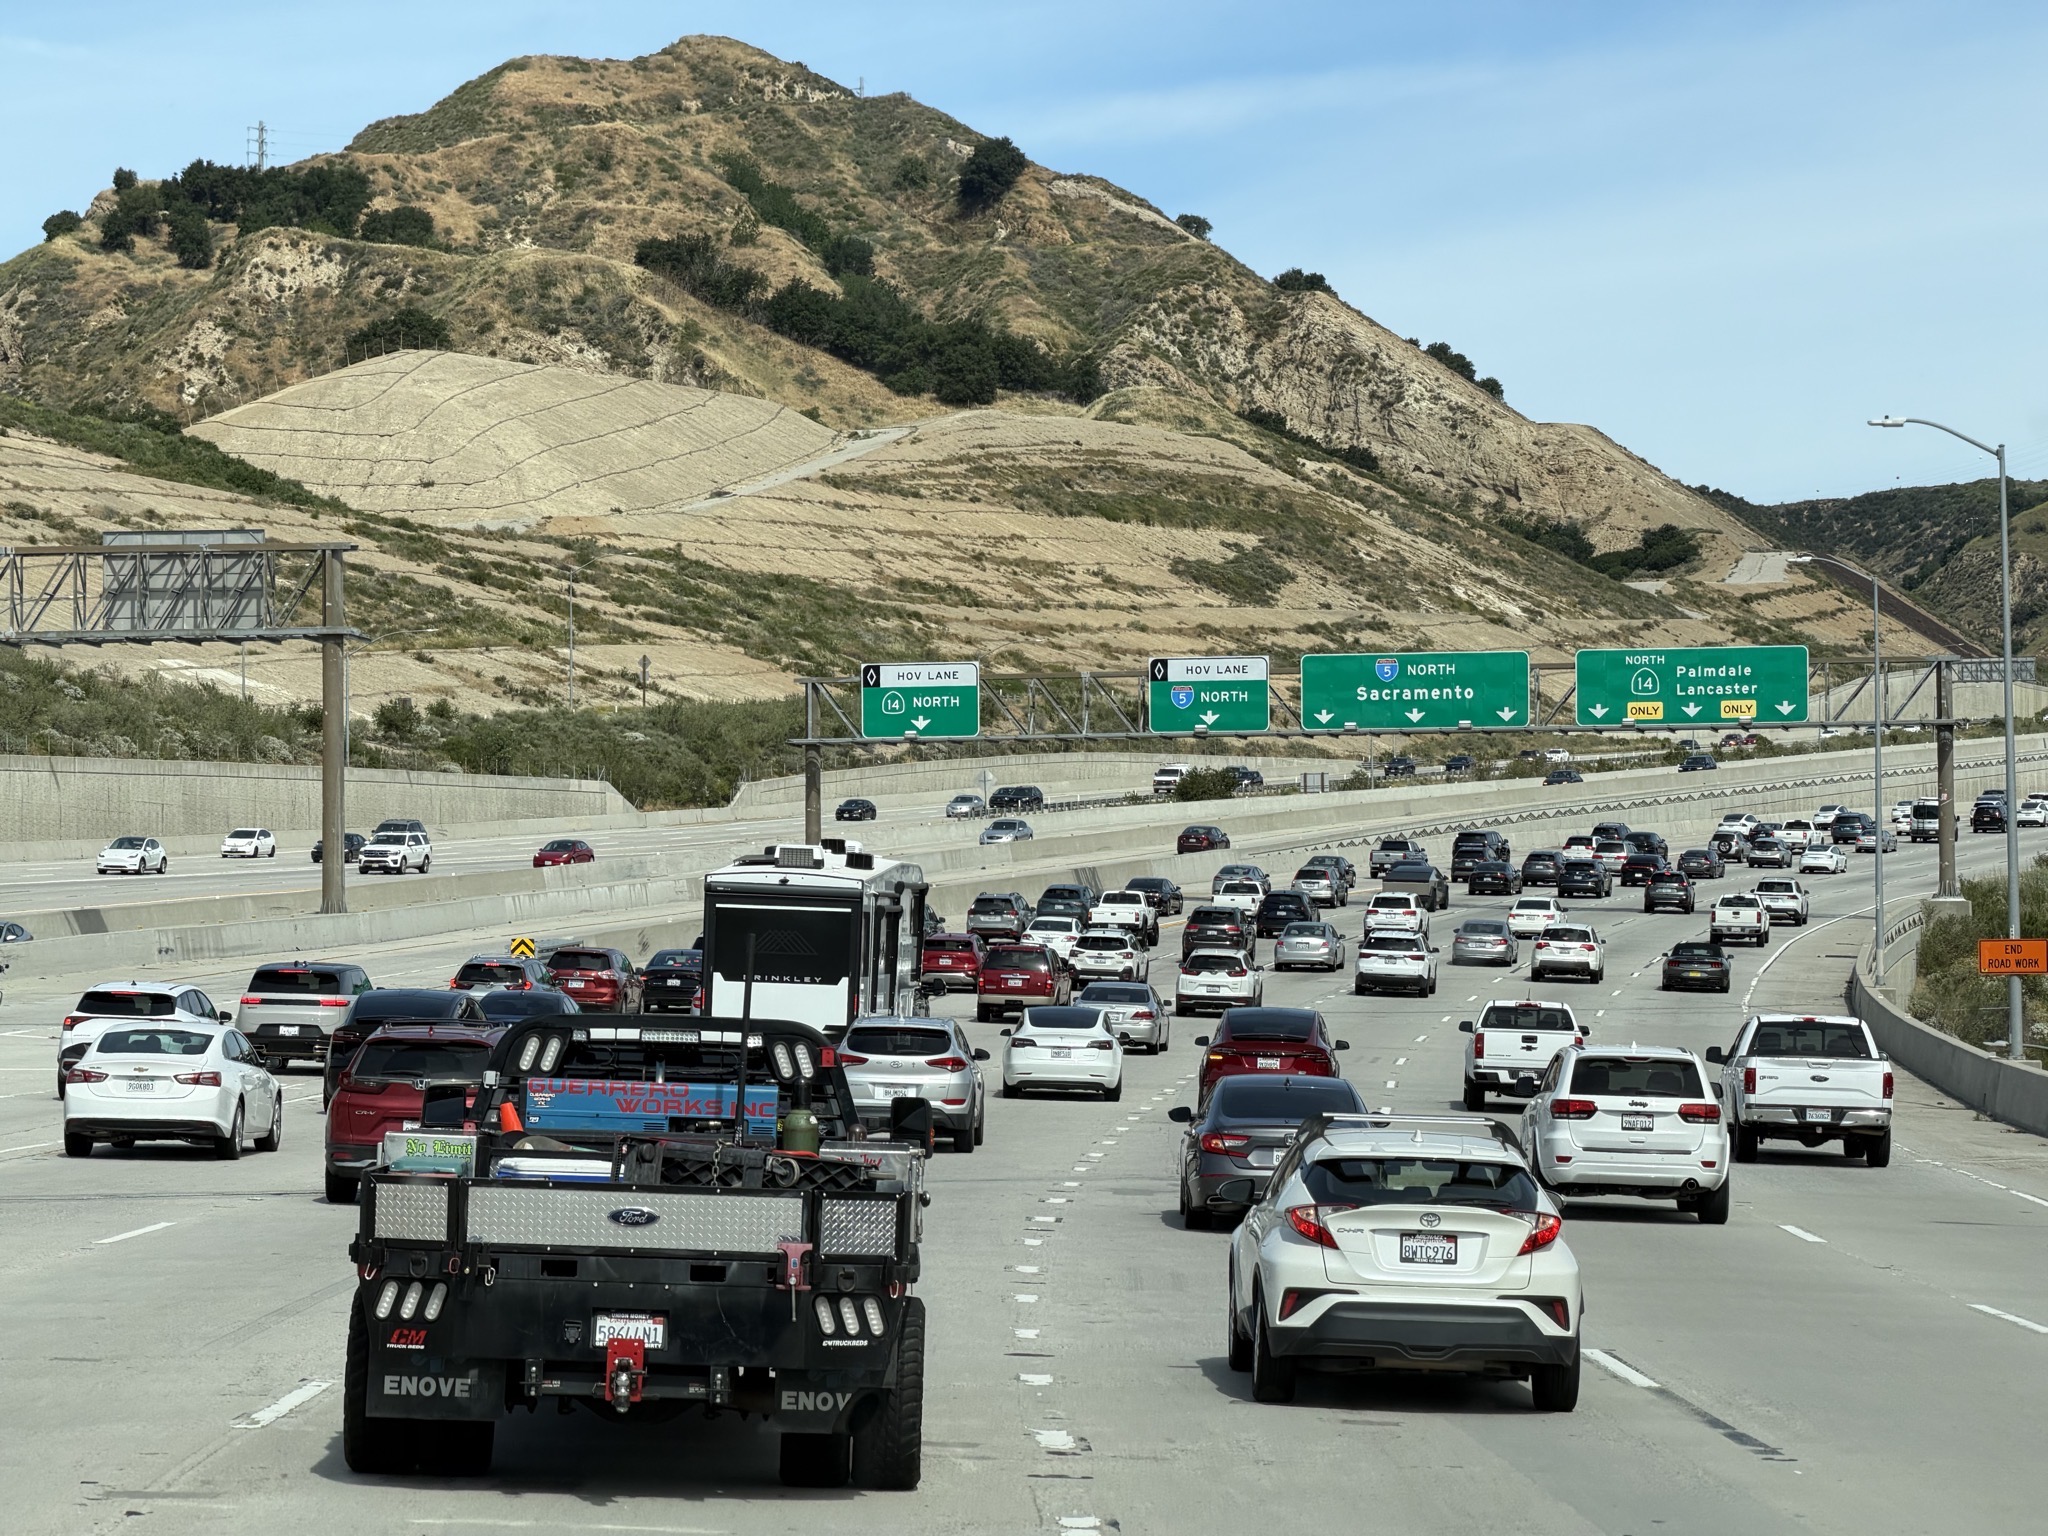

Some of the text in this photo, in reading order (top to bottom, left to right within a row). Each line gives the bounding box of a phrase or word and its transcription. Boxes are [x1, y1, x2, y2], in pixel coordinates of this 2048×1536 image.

[1625, 655, 1665, 665] NORTH
[897, 671, 959, 680] HOV LANE
[1186, 665, 1248, 674] HOV LANE
[1383, 664, 1456, 677] 5 NORTH
[1676, 665, 1752, 677] Palmdale
[1637, 677, 1653, 690] 14
[1676, 683, 1758, 695] Lancaster
[1178, 691, 1248, 704] 5 NORTH
[1356, 685, 1474, 701] Sacramento
[887, 696, 960, 710] 14 NORTH
[1723, 704, 1753, 714] ONLY
[1630, 706, 1660, 715] ONLY
[2004, 944, 2023, 955] END
[1987, 958, 2040, 968] ROAD WORK
[527, 1078, 690, 1098] GUERRERO
[615, 1098, 723, 1115] WORKS
[1629, 1100, 1648, 1108] Jeep
[406, 1138, 473, 1156] No Limit
[619, 1210, 648, 1223] Ford
[390, 1328, 428, 1344] CM
[383, 1375, 471, 1398] ENOVE
[781, 1391, 853, 1412] ENOV
